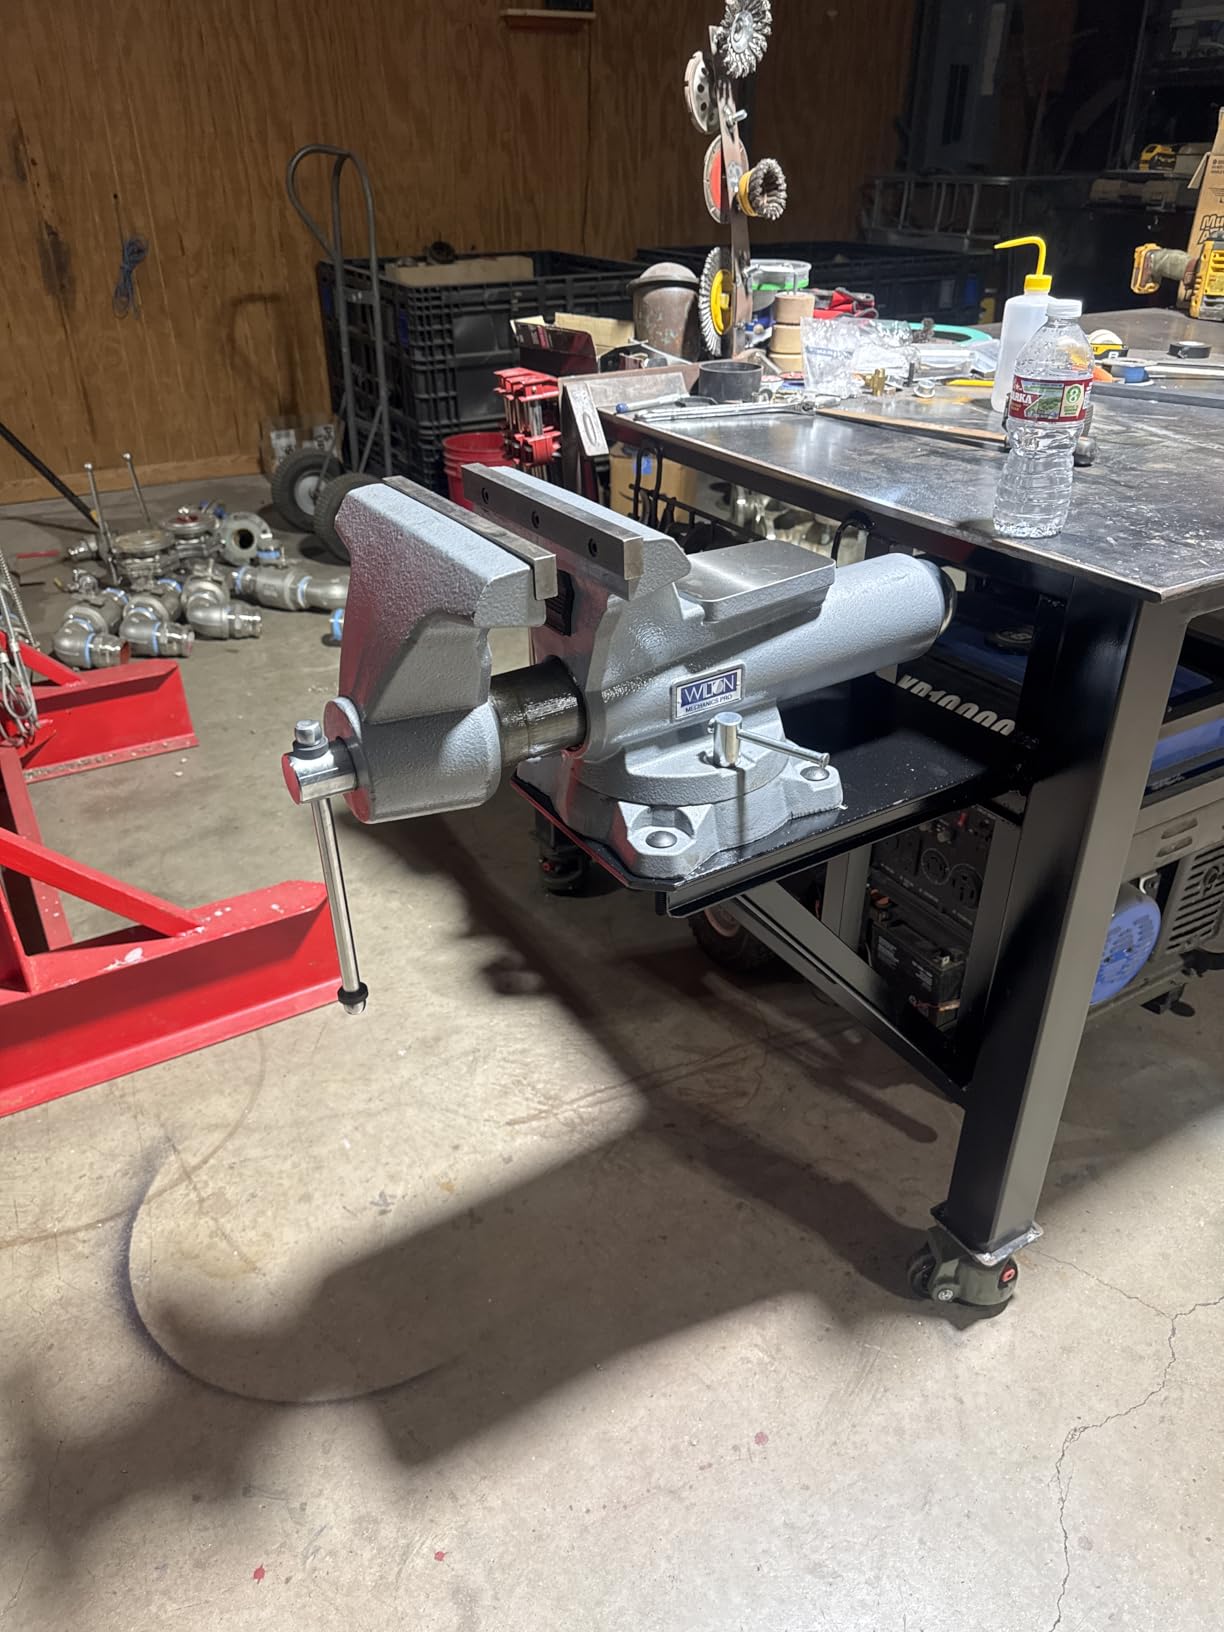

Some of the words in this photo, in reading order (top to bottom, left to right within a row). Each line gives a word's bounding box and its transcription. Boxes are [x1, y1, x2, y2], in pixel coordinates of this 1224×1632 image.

[684, 674, 735, 703] WILTON
[685, 698, 719, 712] MECHANICS
[719, 694, 733, 702] PRO
